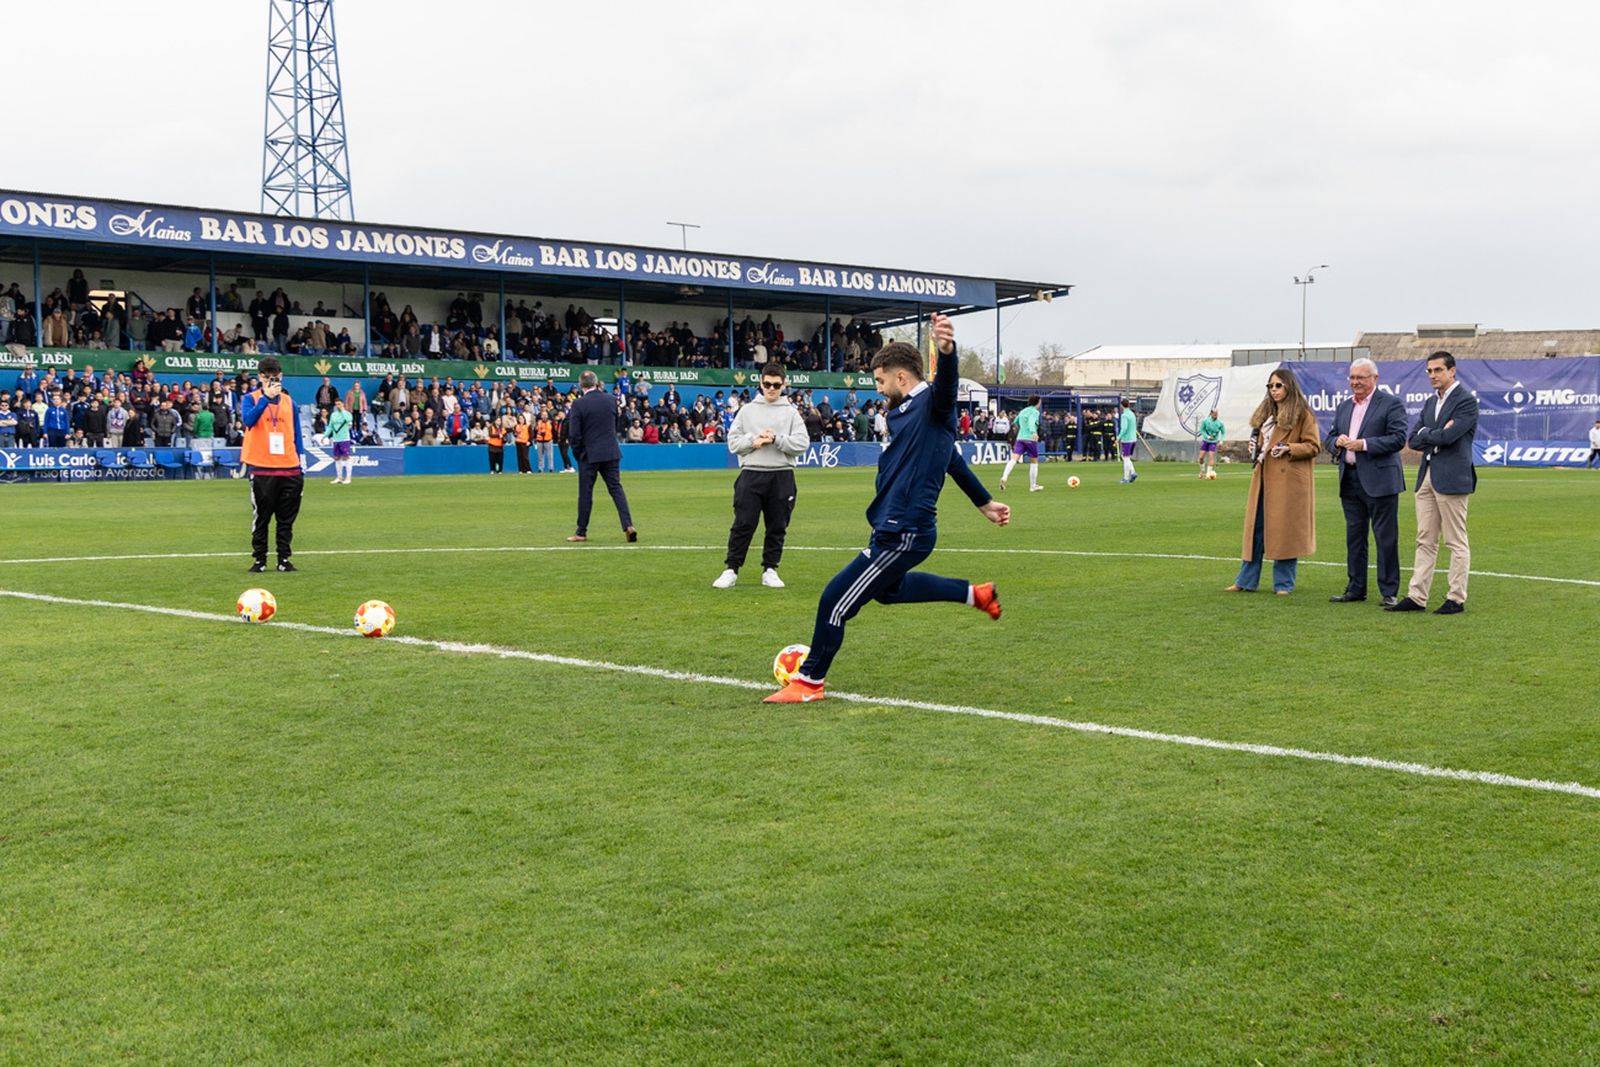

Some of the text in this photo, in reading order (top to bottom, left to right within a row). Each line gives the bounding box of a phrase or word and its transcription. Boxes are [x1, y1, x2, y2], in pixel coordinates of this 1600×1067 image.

[0, 200, 97, 230] ONES
[136, 209, 191, 241] Mañas
[199, 217, 466, 259] BAR LOS JAMONES
[489, 240, 534, 267] Mañas
[539, 245, 742, 280] BAR LOS JAMONES
[798, 267, 956, 297] BAR LOS JAMONES
[165, 356, 193, 368] CAJA
[196, 358, 235, 369] RURAL
[338, 362, 425, 374] CAJA RURAL JAÉN
[495, 366, 571, 378] CAJA RURAL JAÉN
[653, 370, 679, 380] RURAL
[680, 370, 699, 381] JAÉN
[1535, 388, 1600, 405] FMGran
[29, 453, 97, 467] Luis Carlo
[1508, 447, 1593, 462] LOTTO
